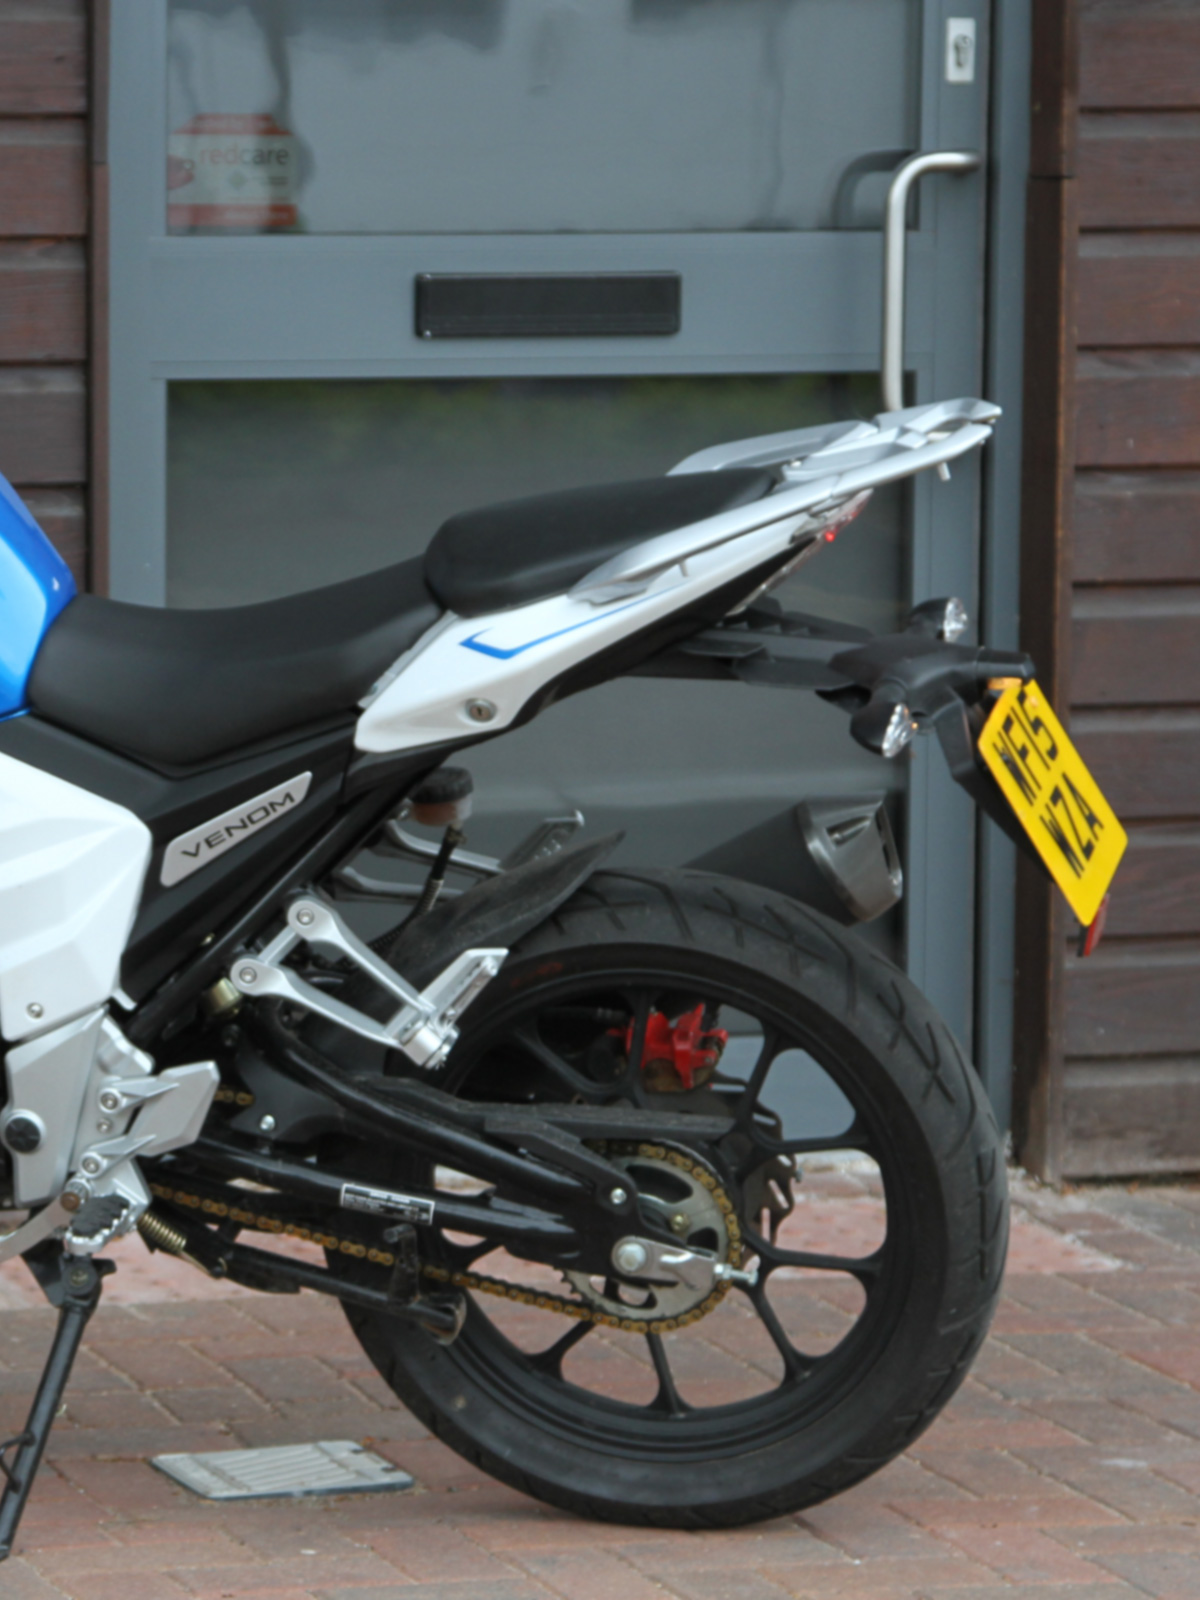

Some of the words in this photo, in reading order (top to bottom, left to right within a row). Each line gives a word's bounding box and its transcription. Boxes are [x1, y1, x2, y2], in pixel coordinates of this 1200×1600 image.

[200, 143, 289, 165] redcare
[992, 690, 1059, 806] WF15
[181, 791, 295, 857] VENOM
[1039, 772, 1104, 879] WZA
